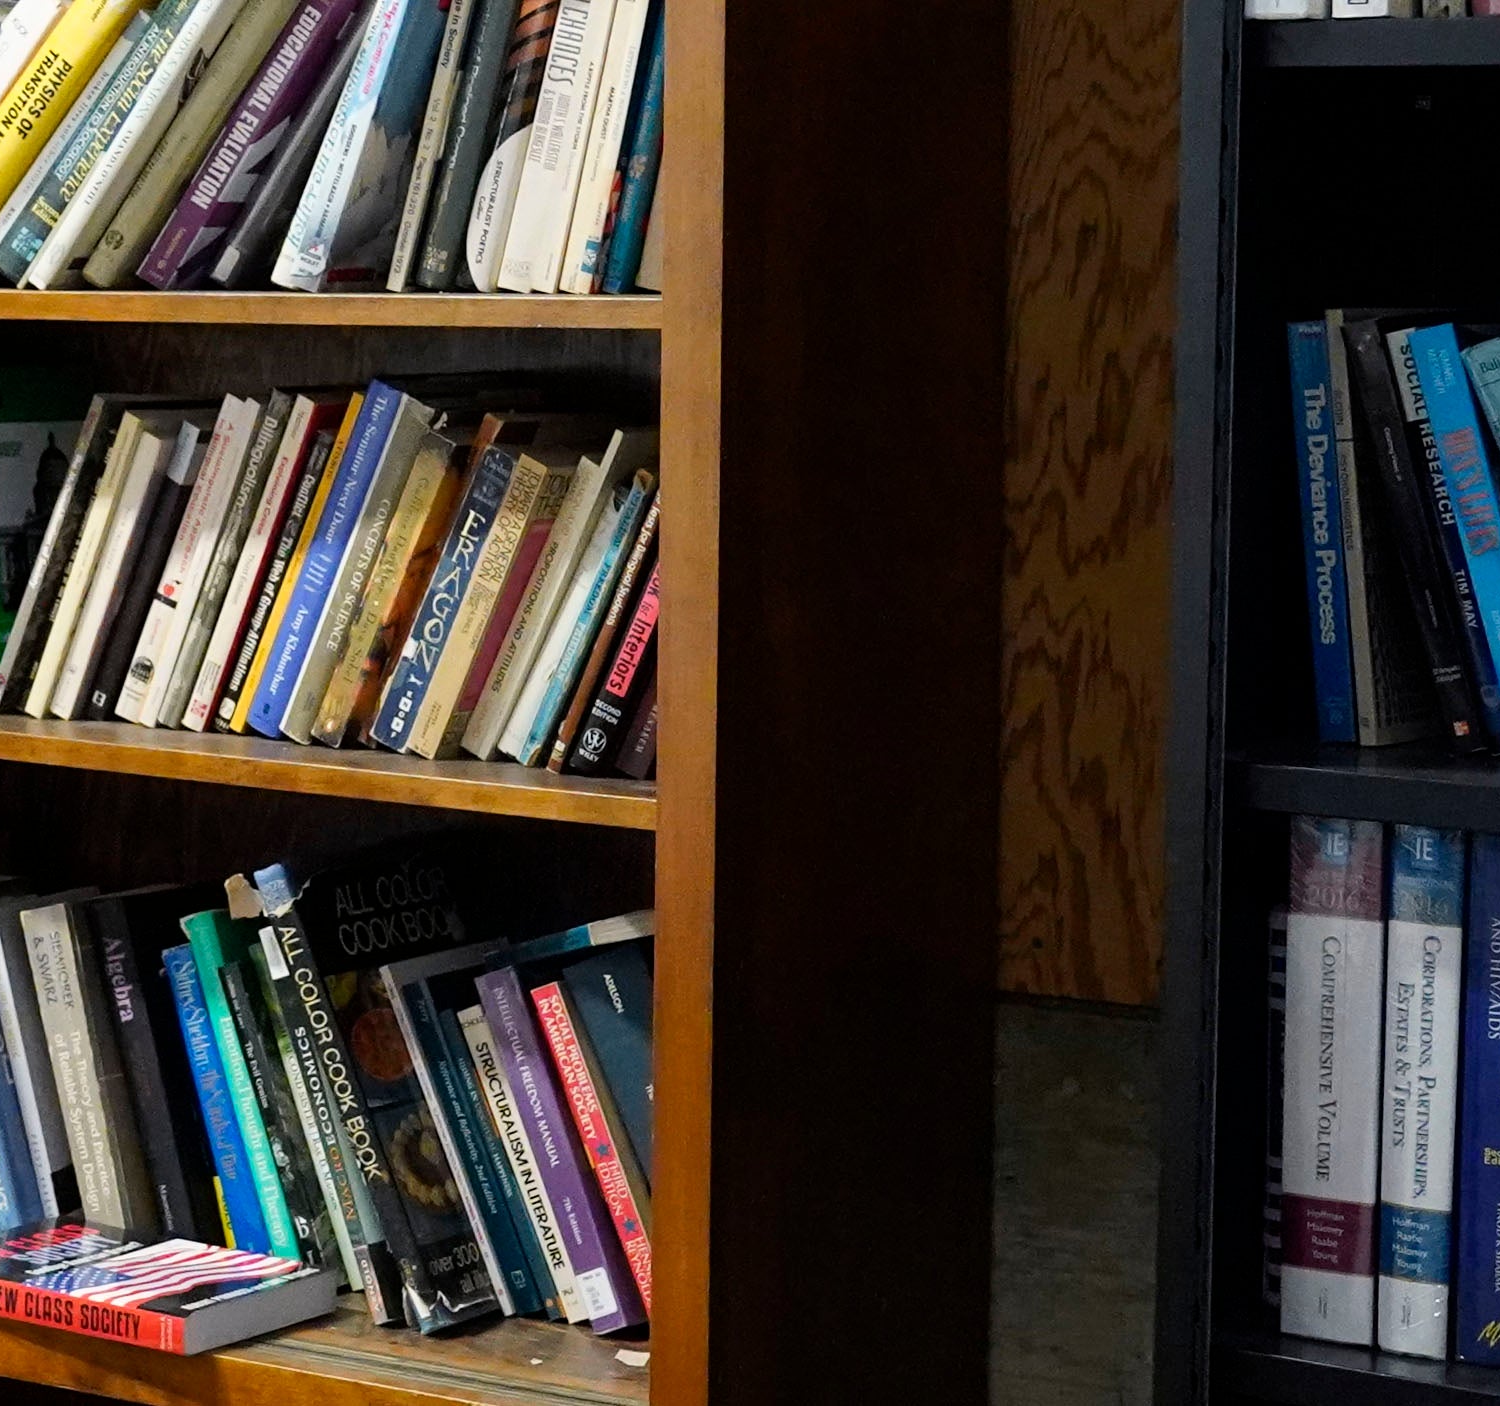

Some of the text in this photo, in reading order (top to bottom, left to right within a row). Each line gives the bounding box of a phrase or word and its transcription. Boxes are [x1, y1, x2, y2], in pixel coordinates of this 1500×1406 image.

[0, 48, 59, 128] TRANSITION
[12, 58, 74, 140] PHYSICS OF
[189, 2, 323, 210] EDUCATIONAL EVALUATION
[440, 14, 461, 68] in Society
[545, 5, 589, 86] CHANCES
[474, 159, 503, 264] STRUCTURALIST POETICS
[322, 394, 388, 545] The Senator Next Door
[1399, 342, 1454, 525] SOCIAL RESEARCH
[227, 473, 317, 692] Conflict The Web of Group-Affiliations
[325, 497, 392, 651] CONCEPTS OF SCIENCE
[1303, 382, 1340, 644] The Deviance Process
[266, 603, 310, 696] Amy Klobuchar
[490, 540, 559, 694] PROPOSITIONS AND ATTITUDES
[607, 616, 651, 692] Interiors
[1453, 569, 1477, 629] TIM MAY
[579, 748, 600, 762] WILEY
[101, 934, 136, 1023] Algebra
[277, 922, 383, 1182] ALL COLOR COOK BOOK
[55, 1033, 101, 1212] of Reliable System Design
[493, 986, 561, 1168] INTELLECTUAL FREEDOM MANUAL
[537, 996, 597, 1141] IN AMERICAN SOCIETY
[548, 993, 598, 1113] SOCIAL PROBLEMS
[1314, 935, 1341, 1181] COMPREHENSIVE VOLUME
[1391, 982, 1416, 1147] ESTATES & TRUSTS
[474, 1040, 565, 1271] STRUCTURALISM IN LITERATURE
[24, 1293, 73, 1326] CLASS
[80, 1304, 140, 1340] SOCIETY
